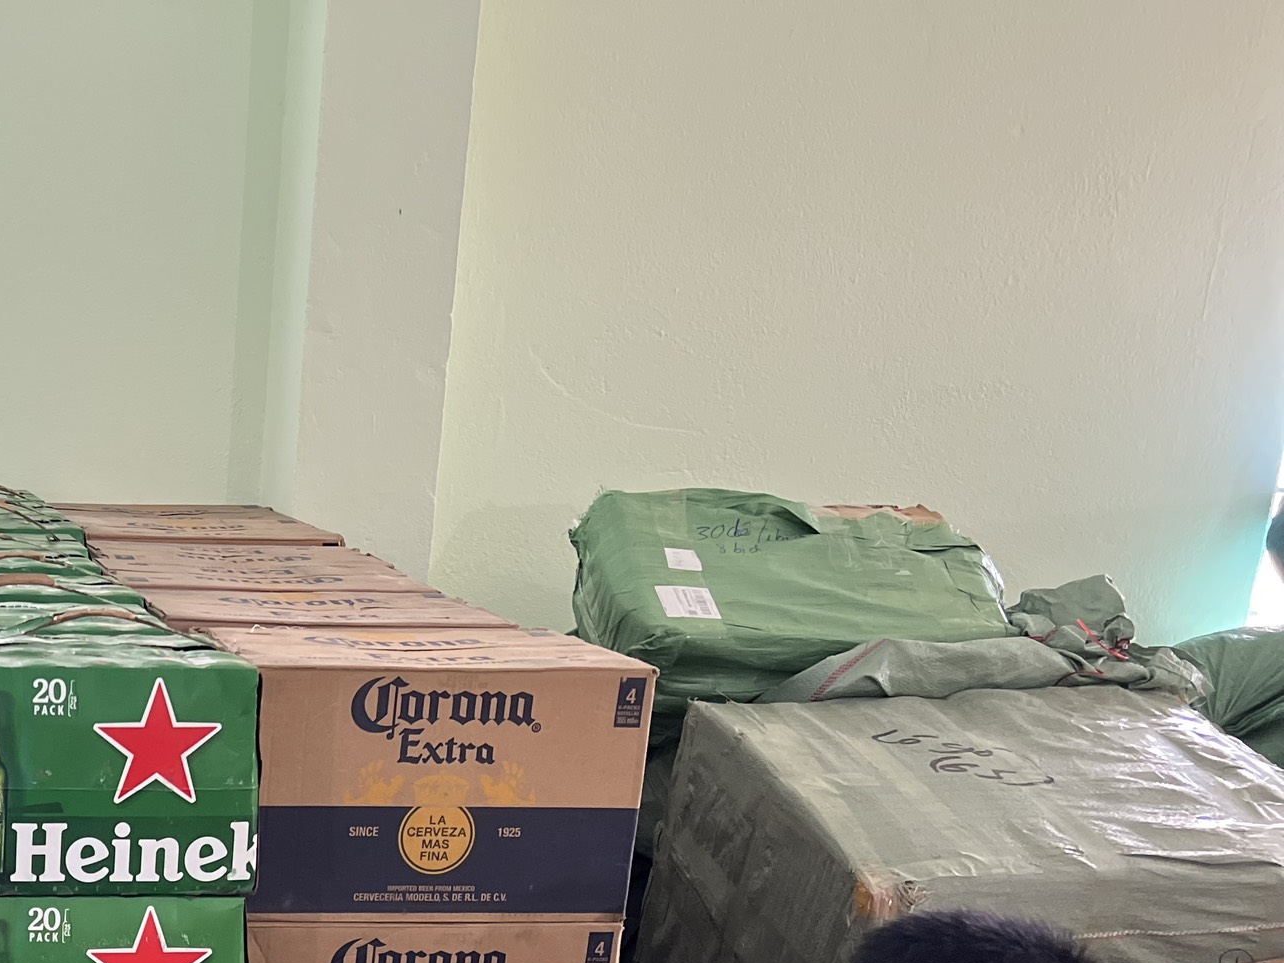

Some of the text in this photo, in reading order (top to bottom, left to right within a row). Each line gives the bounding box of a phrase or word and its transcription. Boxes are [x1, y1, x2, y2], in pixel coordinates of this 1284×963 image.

[32, 678, 66, 703] 20
[626, 688, 636, 704] 4
[34, 705, 64, 716] PACK
[351, 676, 535, 740] Corona
[398, 729, 495, 764] Extra
[430, 816, 446, 824] LA
[349, 827, 378, 836] SINCE
[408, 827, 466, 837] CERVEZA
[498, 828, 521, 838] 1925
[422, 840, 449, 849] MAS
[10, 821, 258, 882] Heinek
[420, 852, 448, 861] FINA
[354, 893, 404, 902] CERVECERIA
[406, 894, 440, 903] MODELO,
[452, 894, 463, 902] DE
[481, 894, 492, 902] DE
[28, 908, 60, 931] 20
[29, 932, 58, 943] PACK
[596, 941, 605, 956] 4
